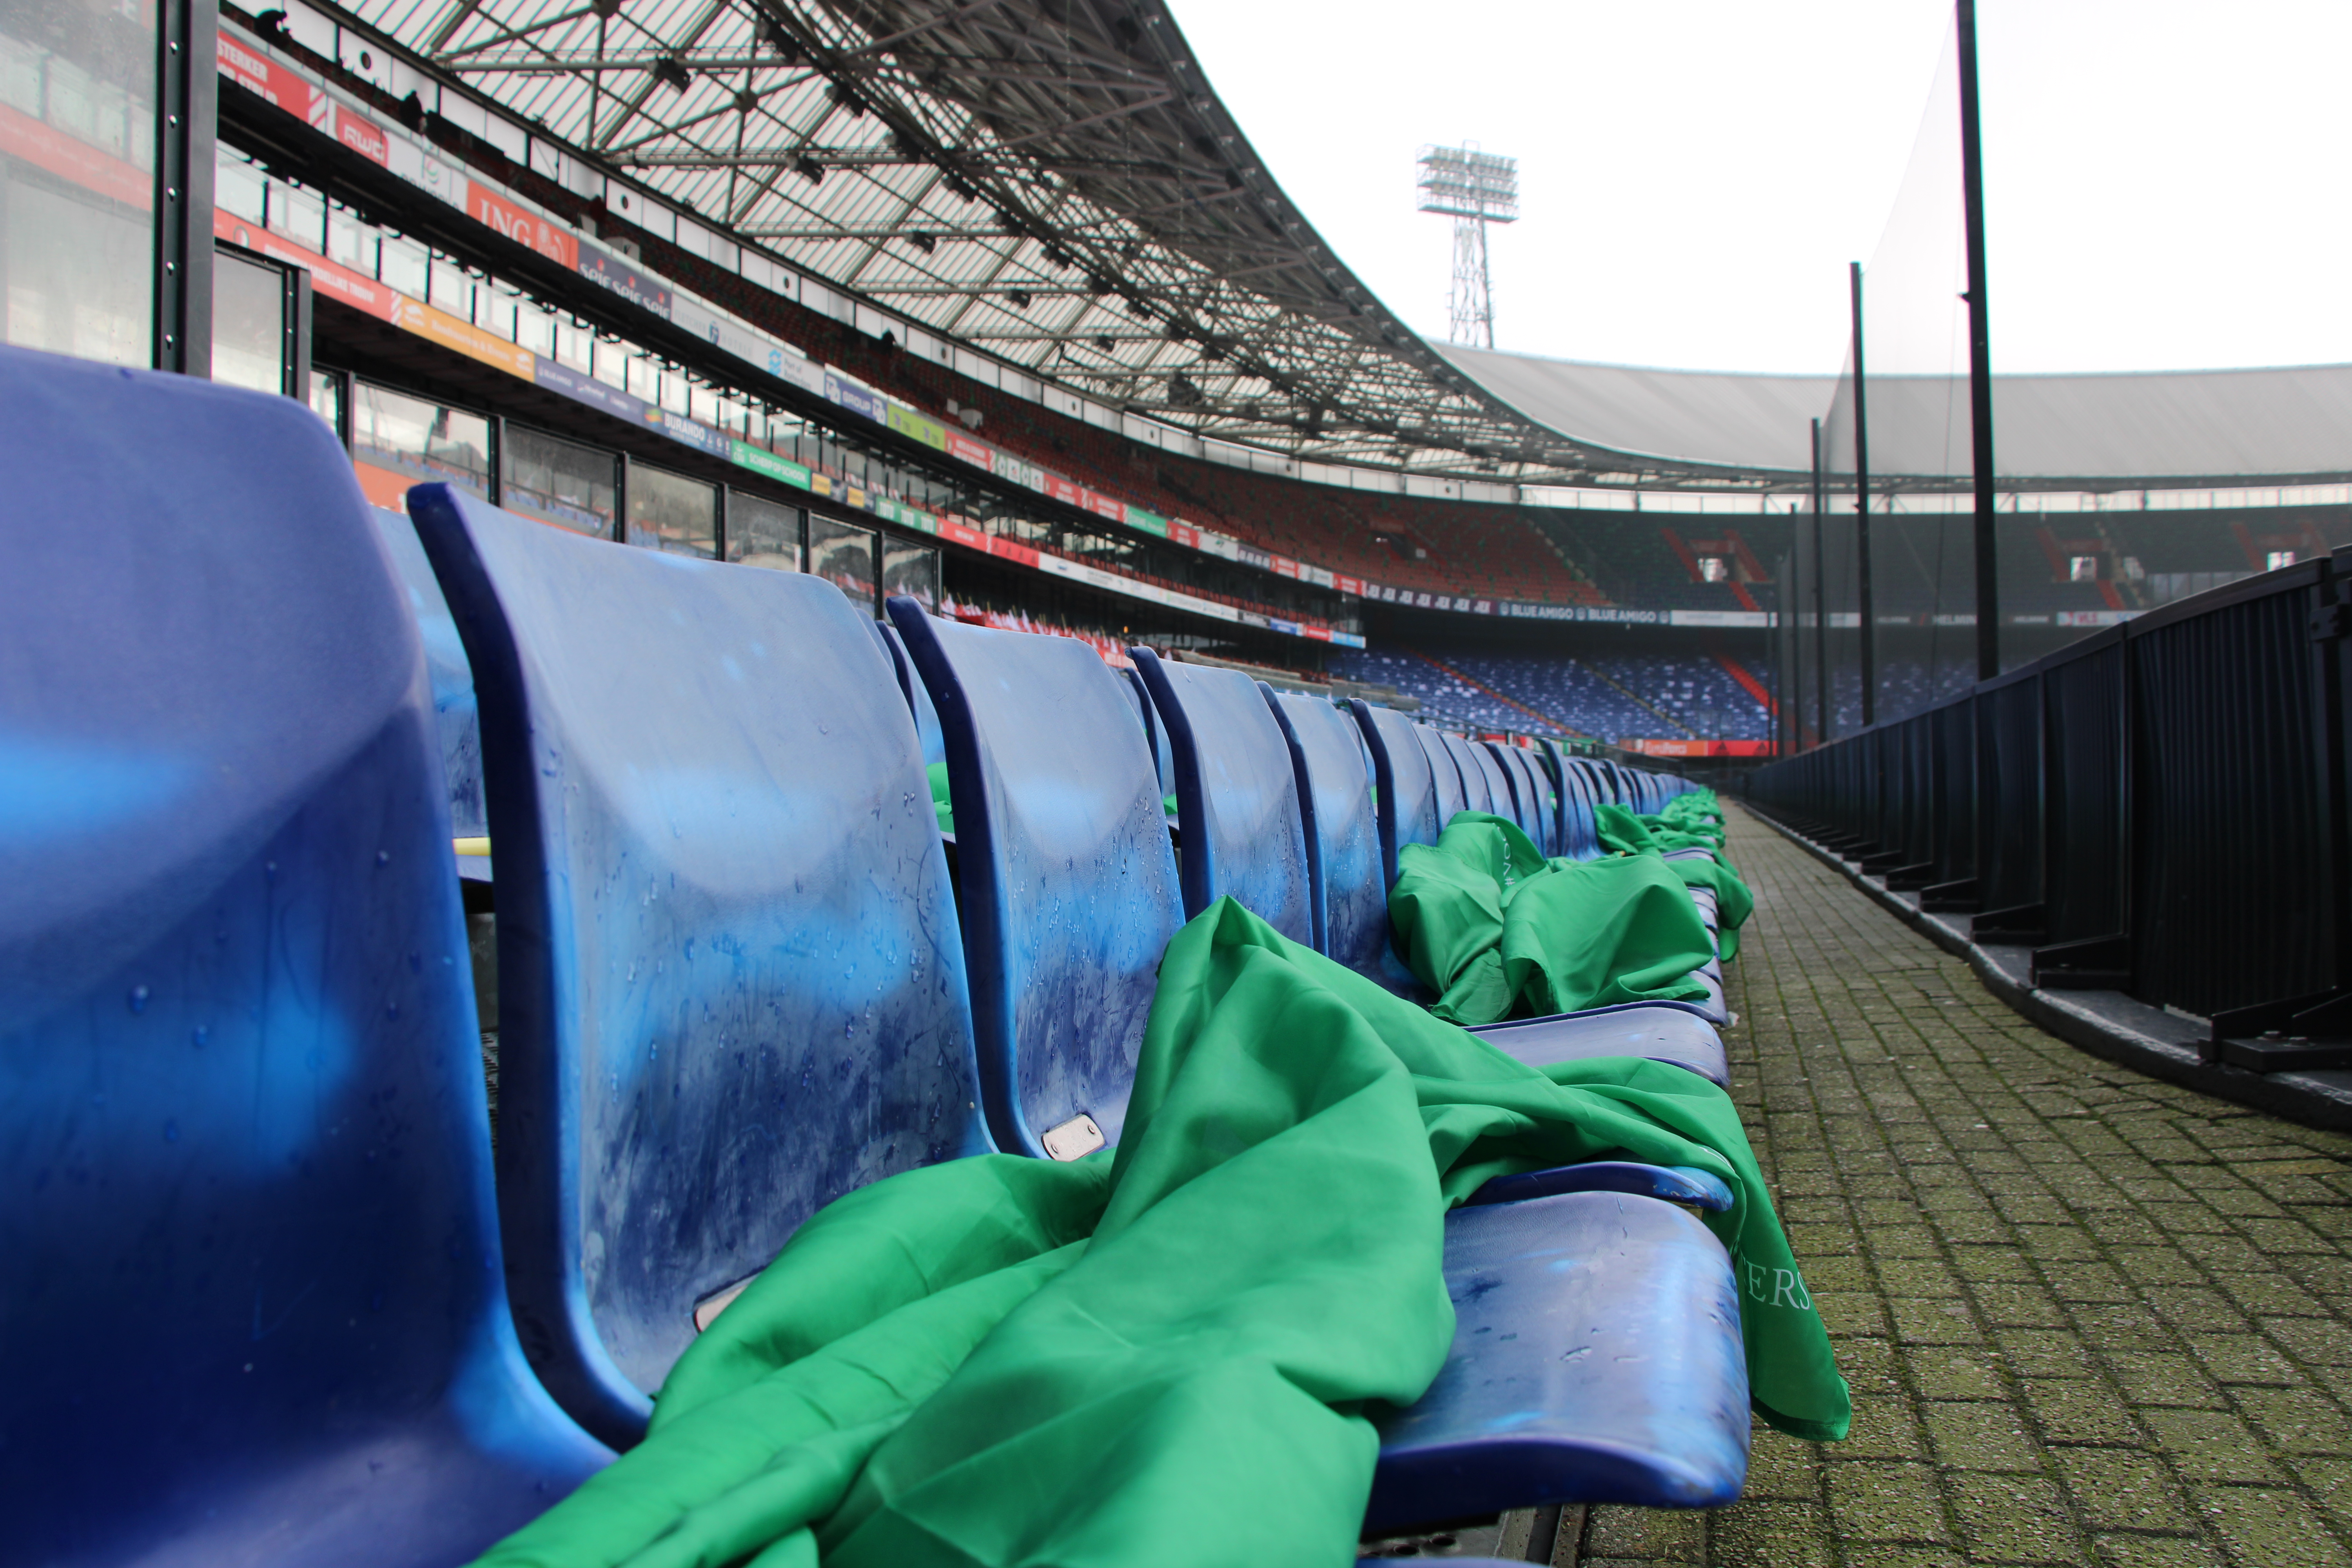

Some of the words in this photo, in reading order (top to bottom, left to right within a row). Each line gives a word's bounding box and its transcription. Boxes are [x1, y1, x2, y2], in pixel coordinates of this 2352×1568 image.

[479, 197, 531, 249] ING
[843, 390, 871, 411] GROUP
[664, 412, 706, 442] BURANDO
[733, 450, 744, 463] CSU
[749, 452, 773, 469] SCHERP
[773, 461, 781, 473] OP
[1511, 604, 1537, 617] BLUE
[1538, 606, 1574, 620] AMIGO
[1587, 608, 1617, 621] BLUE
[1617, 610, 1657, 623] AMIGO
